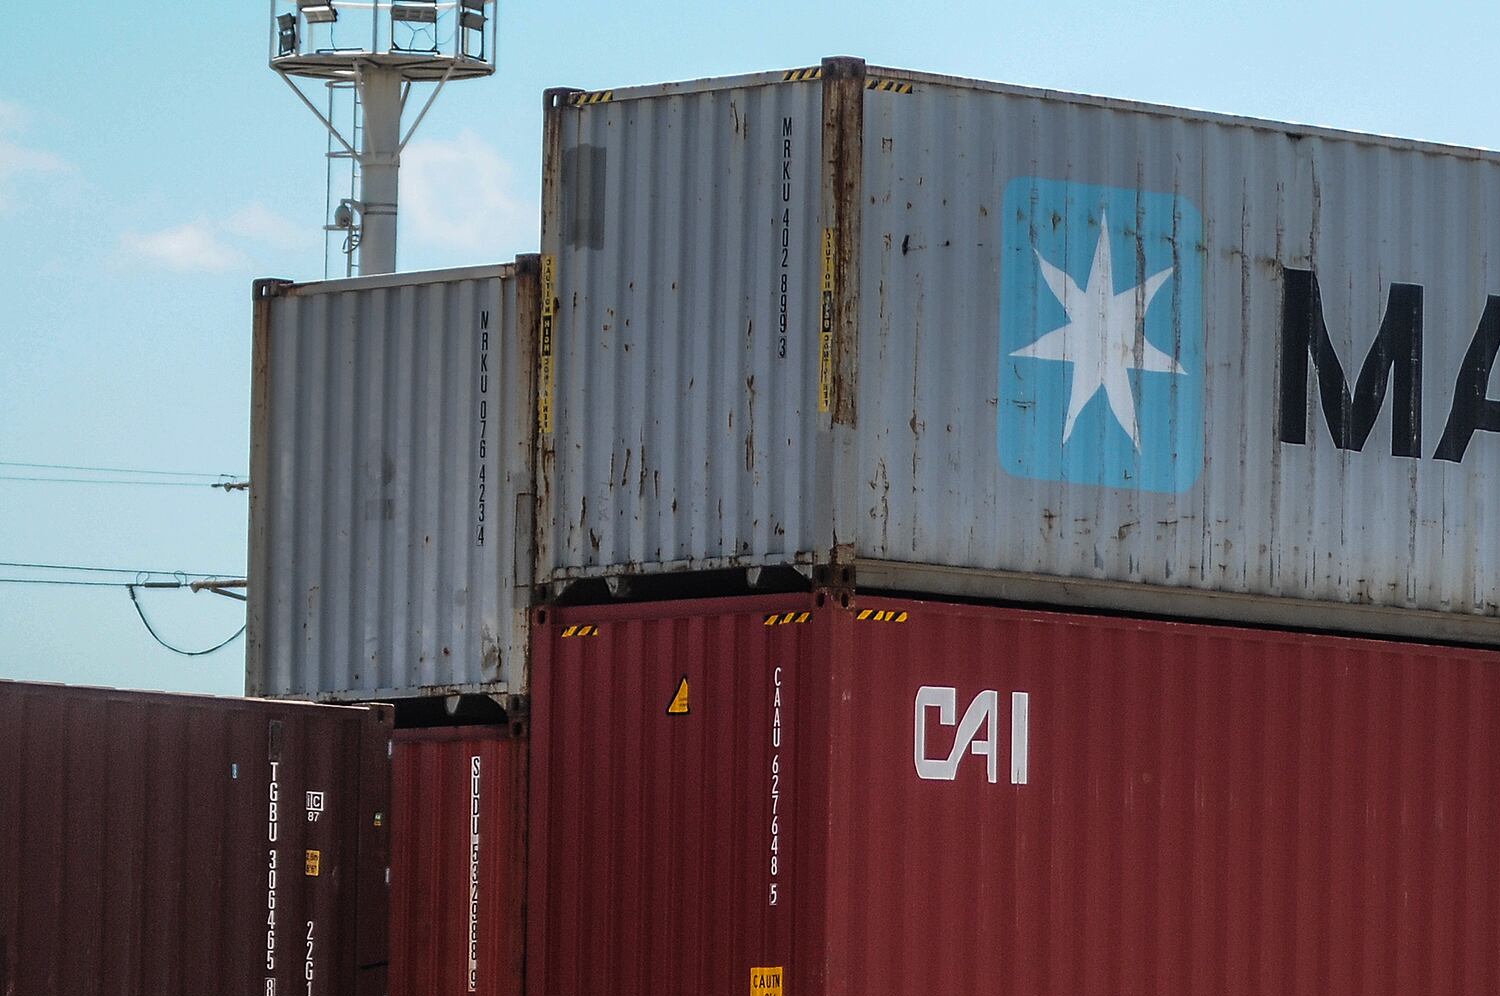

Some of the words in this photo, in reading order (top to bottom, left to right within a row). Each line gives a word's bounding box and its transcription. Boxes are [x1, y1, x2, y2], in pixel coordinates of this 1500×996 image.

[782, 117, 792, 202] MRKU
[780, 208, 790, 268] 402
[779, 273, 788, 333] 899
[480, 310, 489, 394] MRKU
[778, 337, 787, 358] 3
[479, 400, 487, 459] 076
[478, 464, 486, 523] 423
[476, 525, 485, 546] 4
[772, 667, 781, 747] CAAU
[914, 685, 1029, 785] CAI
[268, 762, 279, 842] TGBU
[307, 811, 320, 822] 87
[471, 756, 480, 836] SUDU
[771, 755, 779, 876] 627648
[266, 850, 277, 970] 306465
[770, 883, 777, 905] 5
